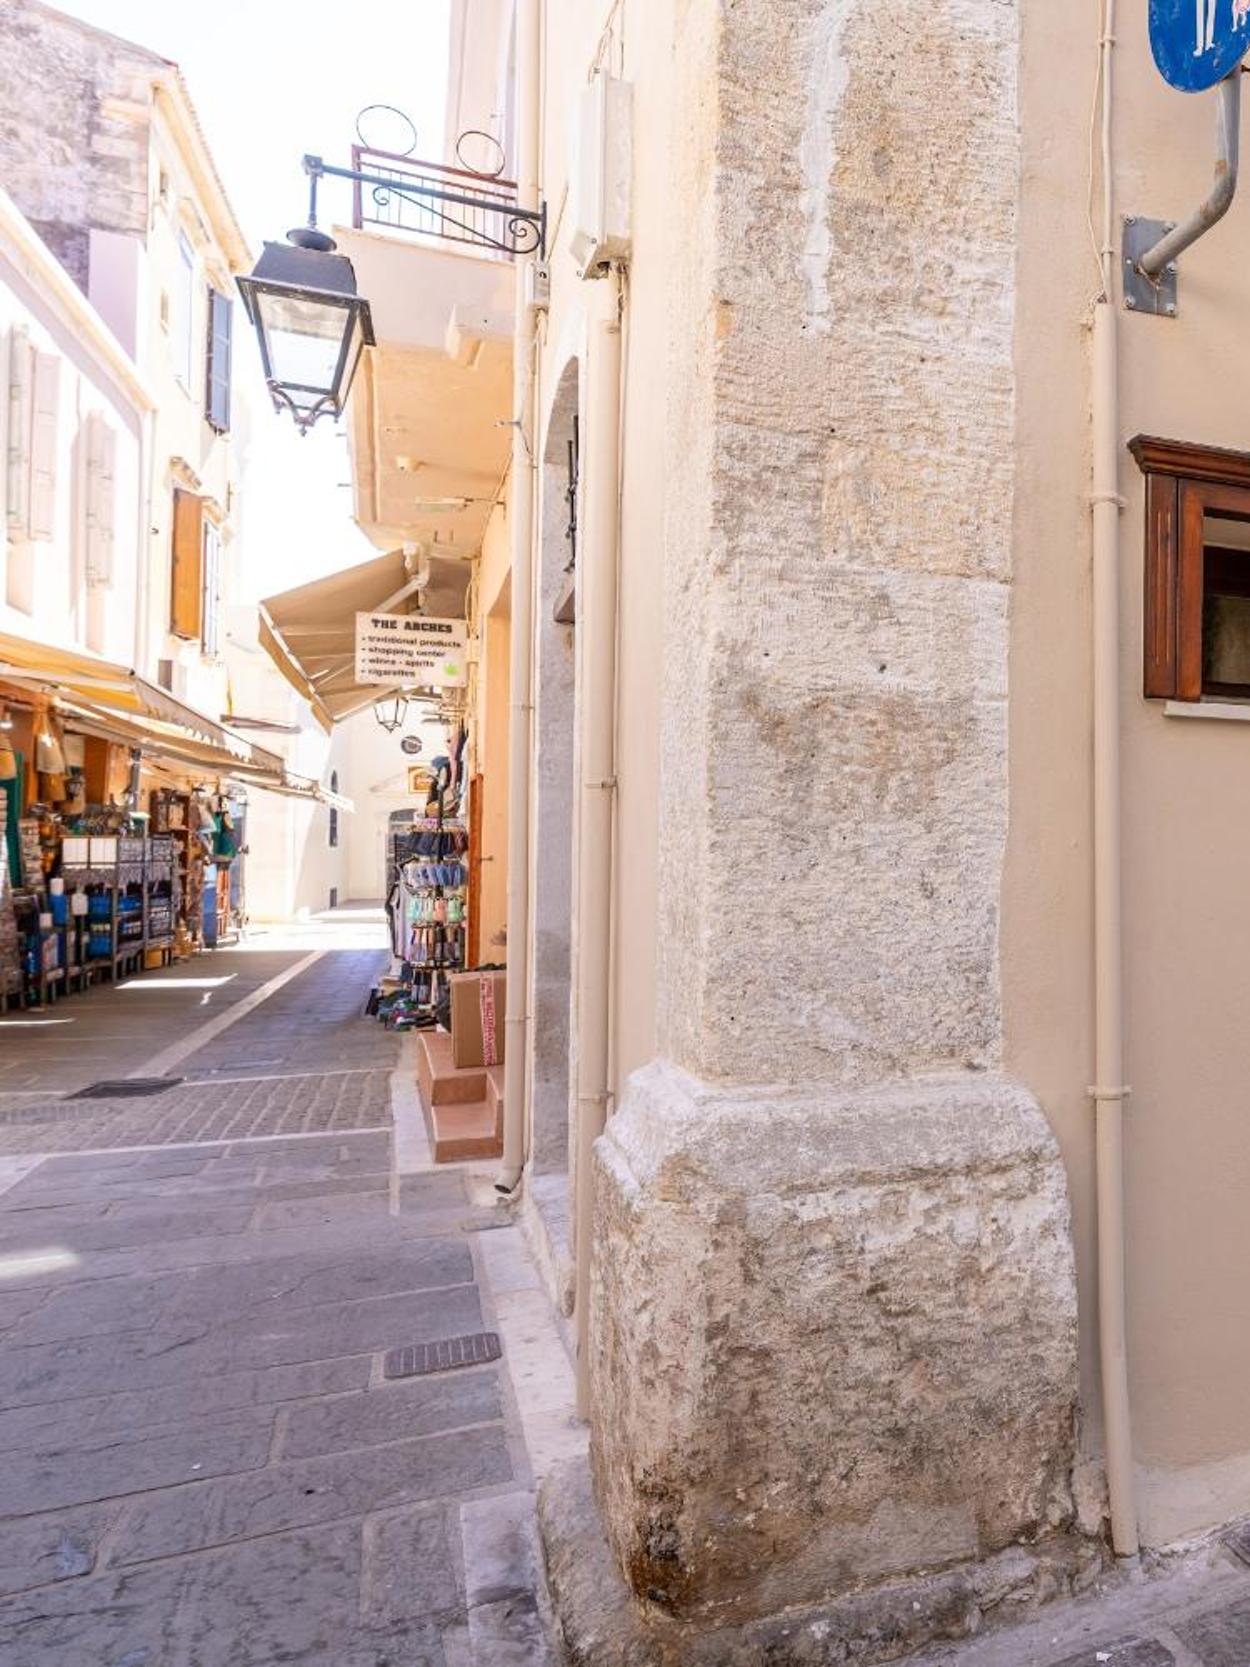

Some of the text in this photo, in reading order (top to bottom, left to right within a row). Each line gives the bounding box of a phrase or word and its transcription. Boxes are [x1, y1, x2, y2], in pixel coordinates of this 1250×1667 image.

[371, 618, 453, 634] THE ARCHES
[368, 635, 462, 649] traditional products
[368, 646, 414, 657] shopping
